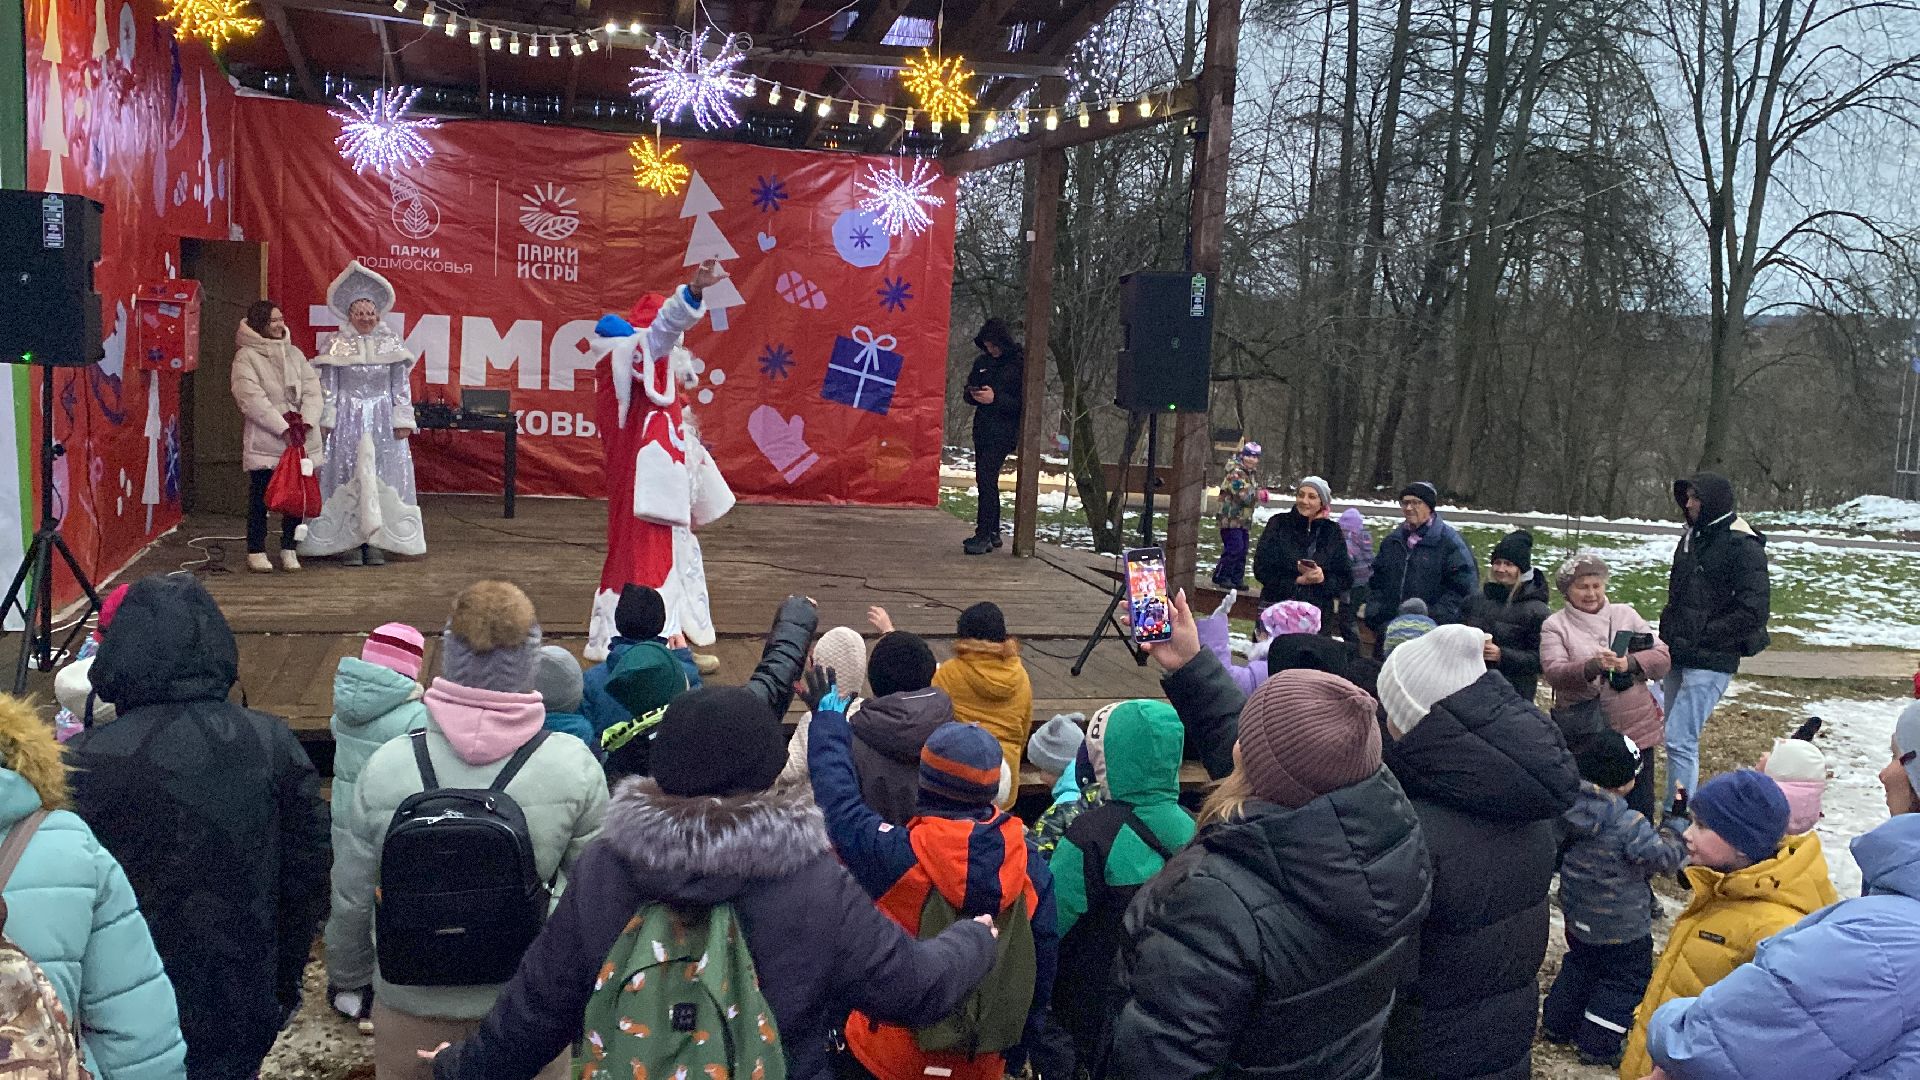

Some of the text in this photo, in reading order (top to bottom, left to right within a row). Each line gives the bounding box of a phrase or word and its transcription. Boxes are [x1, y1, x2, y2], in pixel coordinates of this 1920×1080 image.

[390, 244, 440, 259] ПАРКИ
[517, 243, 579, 265] ПАРКИ
[356, 255, 473, 274] ПОДМОСКОВЬЯ
[517, 261, 578, 283] ИСТРЫ
